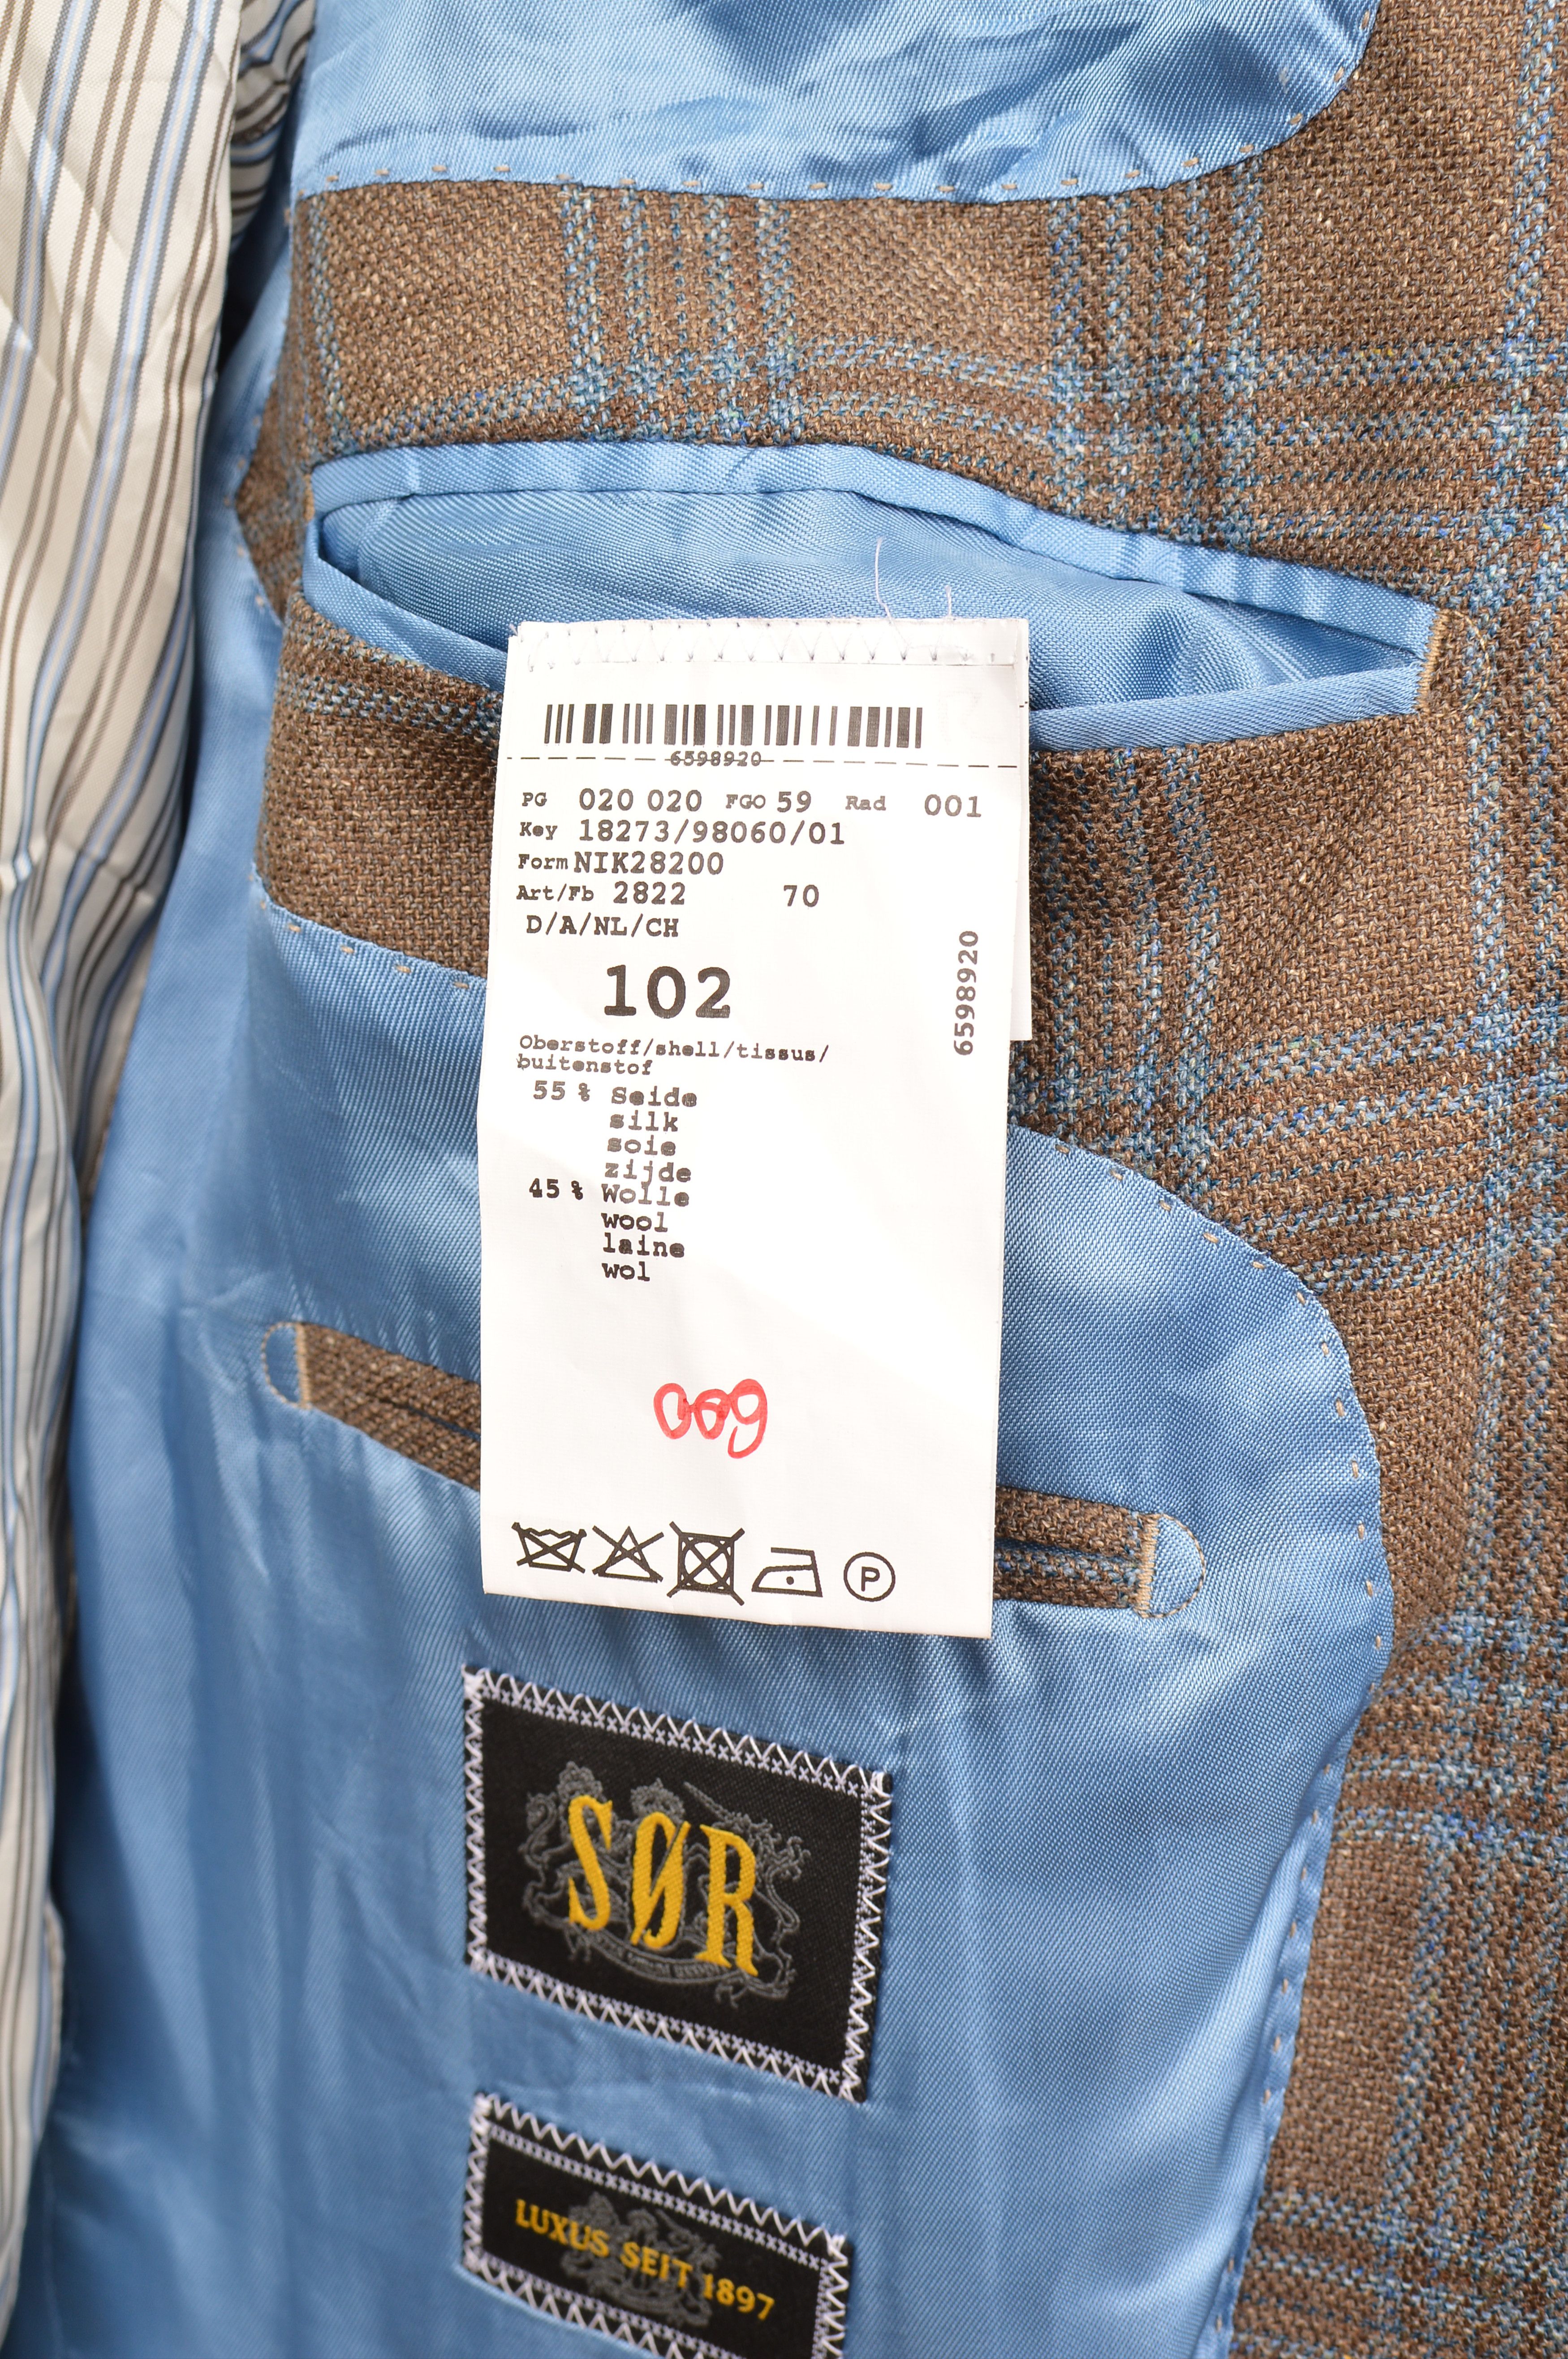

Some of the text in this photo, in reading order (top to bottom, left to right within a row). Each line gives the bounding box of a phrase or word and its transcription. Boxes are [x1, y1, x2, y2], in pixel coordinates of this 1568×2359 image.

[670, 751, 761, 766] 6598920
[522, 793, 547, 806] PG
[580, 788, 633, 811] 020
[648, 790, 702, 812] 020
[777, 791, 811, 812] 59
[845, 796, 886, 810] Rad
[925, 795, 981, 817] 001
[520, 819, 844, 845] Key 18273/98060/01
[518, 851, 723, 875] Form NIK28200
[517, 881, 818, 907] Art/Fb 2822 70
[527, 912, 678, 937] D/A/NL/CH
[604, 965, 730, 1019] 102
[954, 931, 978, 1055] 6598920
[520, 1035, 828, 1063] Oberstoff/shell/tissus/
[518, 1055, 653, 1075] buitenstof
[534, 1081, 697, 1107] 55 % Seide
[610, 1110, 677, 1132] silk
[608, 1135, 676, 1156] soie
[605, 1160, 691, 1184] zijde
[530, 1178, 689, 1206] 45 % Wolle
[602, 1212, 668, 1232] wool
[603, 1233, 684, 1257] laine
[602, 1262, 650, 1281] wol
[569, 1795, 758, 1976] SØR
[517, 2200, 774, 2319] LUXUS SEIT 1897
